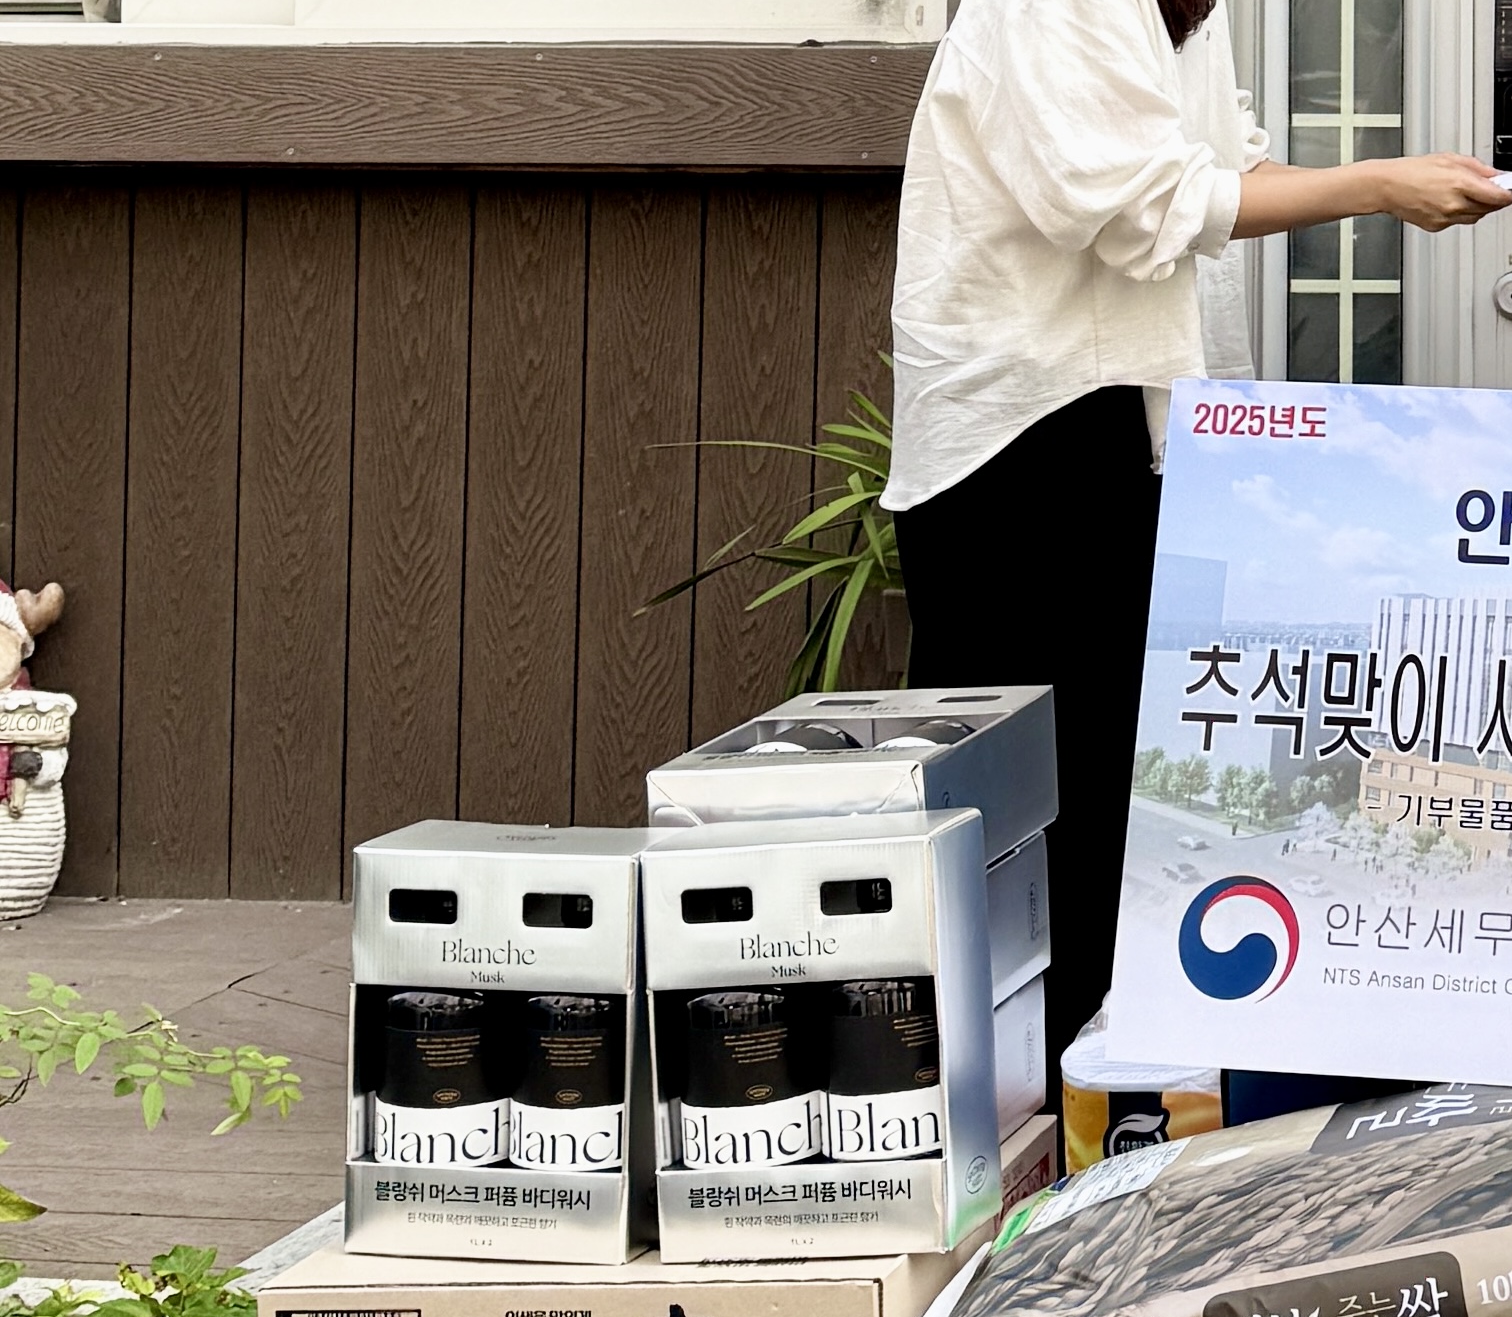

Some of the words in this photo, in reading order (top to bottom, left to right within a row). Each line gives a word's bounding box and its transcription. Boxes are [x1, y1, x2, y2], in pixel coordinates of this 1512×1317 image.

[1192, 402, 1328, 438] 2025년도
[1180, 644, 1449, 763] 추석맞이
[442, 939, 537, 965] Blanche
[740, 931, 840, 960] Blanche
[470, 970, 506, 984] Musk
[771, 963, 807, 978] Musk
[1323, 967, 1361, 987] NTS
[1367, 970, 1425, 990] Ansan
[1432, 974, 1498, 995] District
[374, 1180, 425, 1203] 블랑쉬
[429, 1183, 480, 1204] 머스크
[483, 1185, 518, 1207] 퍼퓸
[522, 1187, 592, 1211] 바디워시
[688, 1184, 741, 1209] 블랑쉬
[745, 1183, 798, 1206] 머스크
[802, 1181, 838, 1203] 퍼퓸
[842, 1178, 912, 1202] 바디워시
